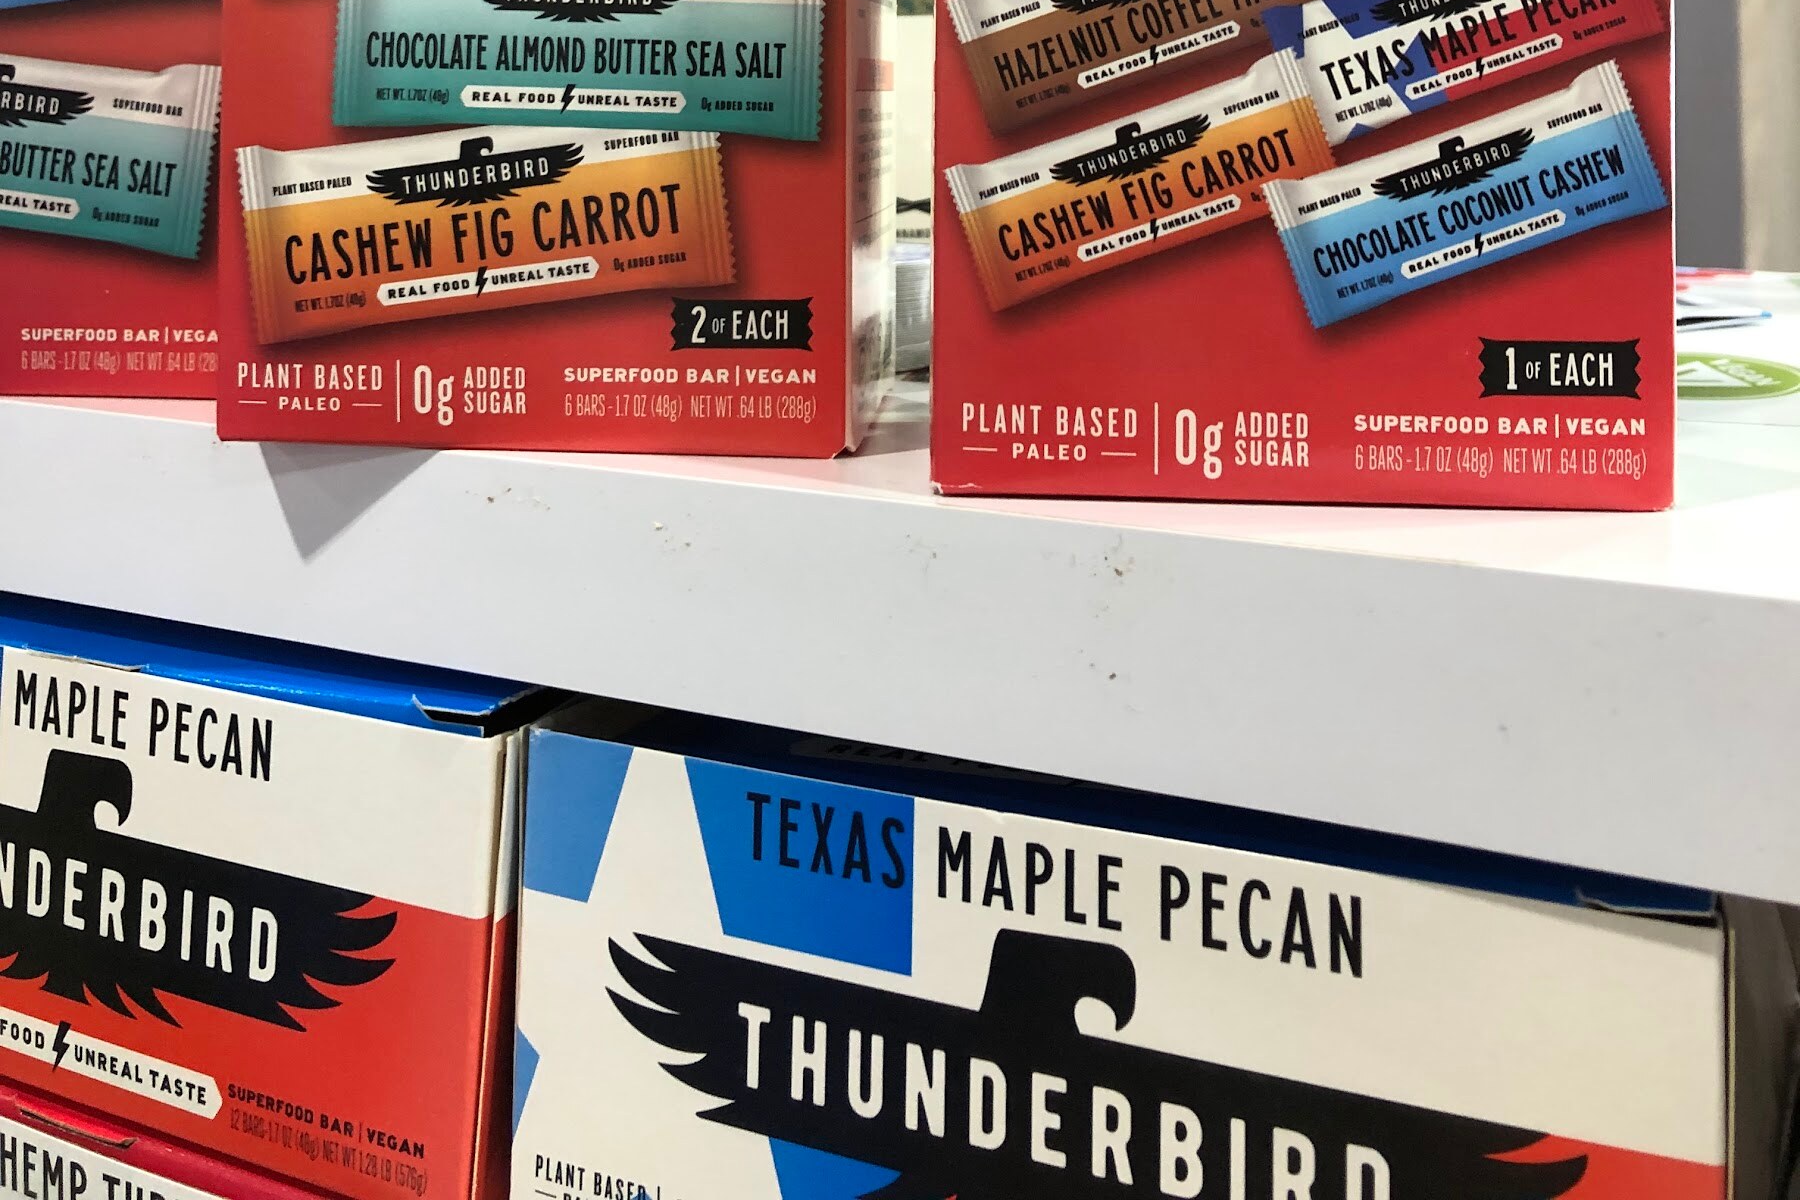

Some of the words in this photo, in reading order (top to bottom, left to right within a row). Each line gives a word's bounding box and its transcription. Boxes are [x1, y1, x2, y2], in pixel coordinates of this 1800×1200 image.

[366, 31, 488, 70] CHOCOLATE
[498, 36, 585, 74] ALMOND
[594, 38, 677, 76] BUTTER
[686, 40, 726, 78] SEA
[735, 43, 786, 79] SALT
[993, 15, 1122, 92] HAZELNUT
[1320, 38, 1415, 100] TEXAS
[1418, 2, 1518, 68] MAPLE
[1, 91, 60, 115] RBIRD
[472, 91, 511, 103] REAL
[518, 93, 556, 105] FOOD
[578, 95, 630, 107] UNREAL
[636, 96, 677, 108] TASTE
[715, 99, 742, 111] ADDED
[0, 140, 77, 184] BUTTER
[82, 152, 120, 191] SEA
[127, 158, 177, 198] SALT
[1077, 128, 1188, 178] THUNDERBIRD
[1399, 142, 1511, 193] THUNDERBIRD
[402, 157, 550, 194] THUNDERBIRD
[998, 190, 1115, 262] CASHEW
[1120, 171, 1174, 222] FIG
[1181, 128, 1297, 199] CARROT
[1313, 210, 1435, 278] CHOCOLATE
[1438, 174, 1536, 235] COCONUT
[1538, 143, 1625, 201] CASHEW
[285, 217, 433, 285] CASHEW
[452, 207, 514, 264] FIG
[532, 183, 682, 252] CARROT
[387, 285, 428, 299] REAL
[433, 279, 470, 294] FOOD
[491, 271, 545, 286] UNREAL
[548, 263, 591, 278] TASTE
[21, 328, 117, 341] SUPERFOOD
[124, 329, 159, 342] BAR
[691, 305, 707, 344] 2
[712, 317, 725, 334] OF
[732, 309, 789, 340] EACH
[238, 362, 303, 389] PLANT
[314, 365, 383, 390] BASED
[463, 366, 526, 389] ADDED
[564, 367, 679, 383] SUPERFOOD
[686, 368, 729, 384] BAR
[746, 368, 816, 384] VEGAN
[1505, 347, 1518, 390] 1
[1526, 361, 1541, 380] OF
[1550, 353, 1614, 387] EACH
[278, 396, 341, 411] PALEO
[414, 365, 455, 426] 0g
[463, 391, 526, 414] SUGAR
[565, 393, 572, 416] 6
[633, 394, 647, 417] OZ
[651, 394, 682, 423] (48g)
[690, 395, 711, 417] NET
[715, 395, 733, 417] WT
[759, 396, 772, 418] LB
[963, 402, 1042, 435] PLANT
[1056, 406, 1138, 438] BASED
[1234, 411, 1309, 439] ADDED
[1354, 414, 1489, 434] SUPERFOOD
[1499, 416, 1547, 435] BAR
[1566, 418, 1646, 436] VEGAN
[1012, 442, 1087, 461] PALEO
[1175, 408, 1224, 480] 0g
[1234, 440, 1309, 467] SUGAR
[1355, 445, 1364, 470] 6
[1436, 447, 1451, 472] OZ
[1457, 447, 1493, 478] (48g)
[1504, 448, 1527, 473] NET
[1532, 448, 1552, 474] WT
[1582, 449, 1597, 475] LB
[1602, 449, 1647, 480] (288g)
[14, 669, 130, 750] MAPLE
[149, 697, 273, 782] PECAN
[746, 791, 906, 889] TEXAS
[938, 826, 1124, 932] MAPLE
[1160, 865, 1364, 979] PECAN
[0, 1019, 45, 1050] FOOD
[74, 1044, 143, 1083] UNREAL
[149, 1069, 206, 1105] TASTE
[737, 1001, 1392, 1200] THUNDERBIRD
[228, 1083, 314, 1124] SUPERFOOD
[320, 1113, 354, 1138] BAR
[367, 1127, 425, 1159] VEGAN
[535, 1154, 586, 1191] PLANT
